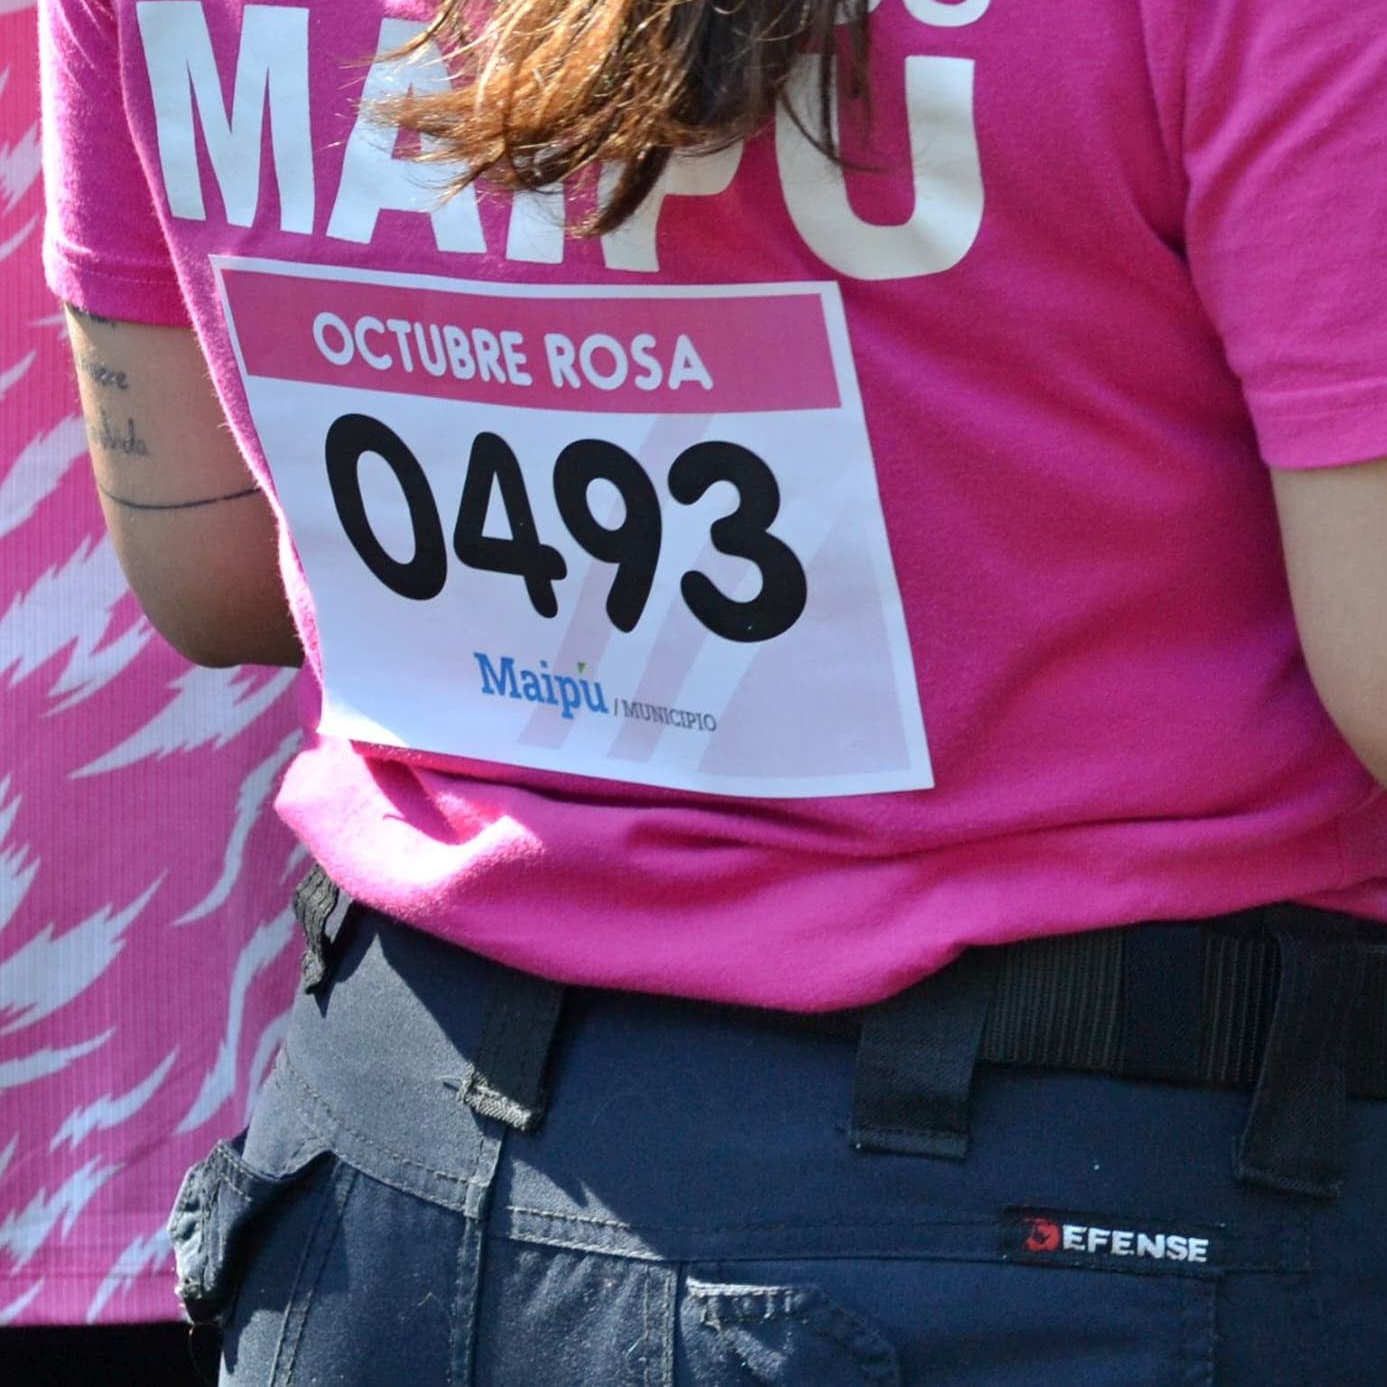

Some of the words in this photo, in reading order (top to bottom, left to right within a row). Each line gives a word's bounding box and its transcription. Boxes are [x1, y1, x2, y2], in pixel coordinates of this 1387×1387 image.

[312, 311, 533, 387] OCTUBRE
[547, 333, 714, 392] ROSA
[324, 413, 808, 644] 0493
[621, 700, 717, 732] MUNICIPIO
